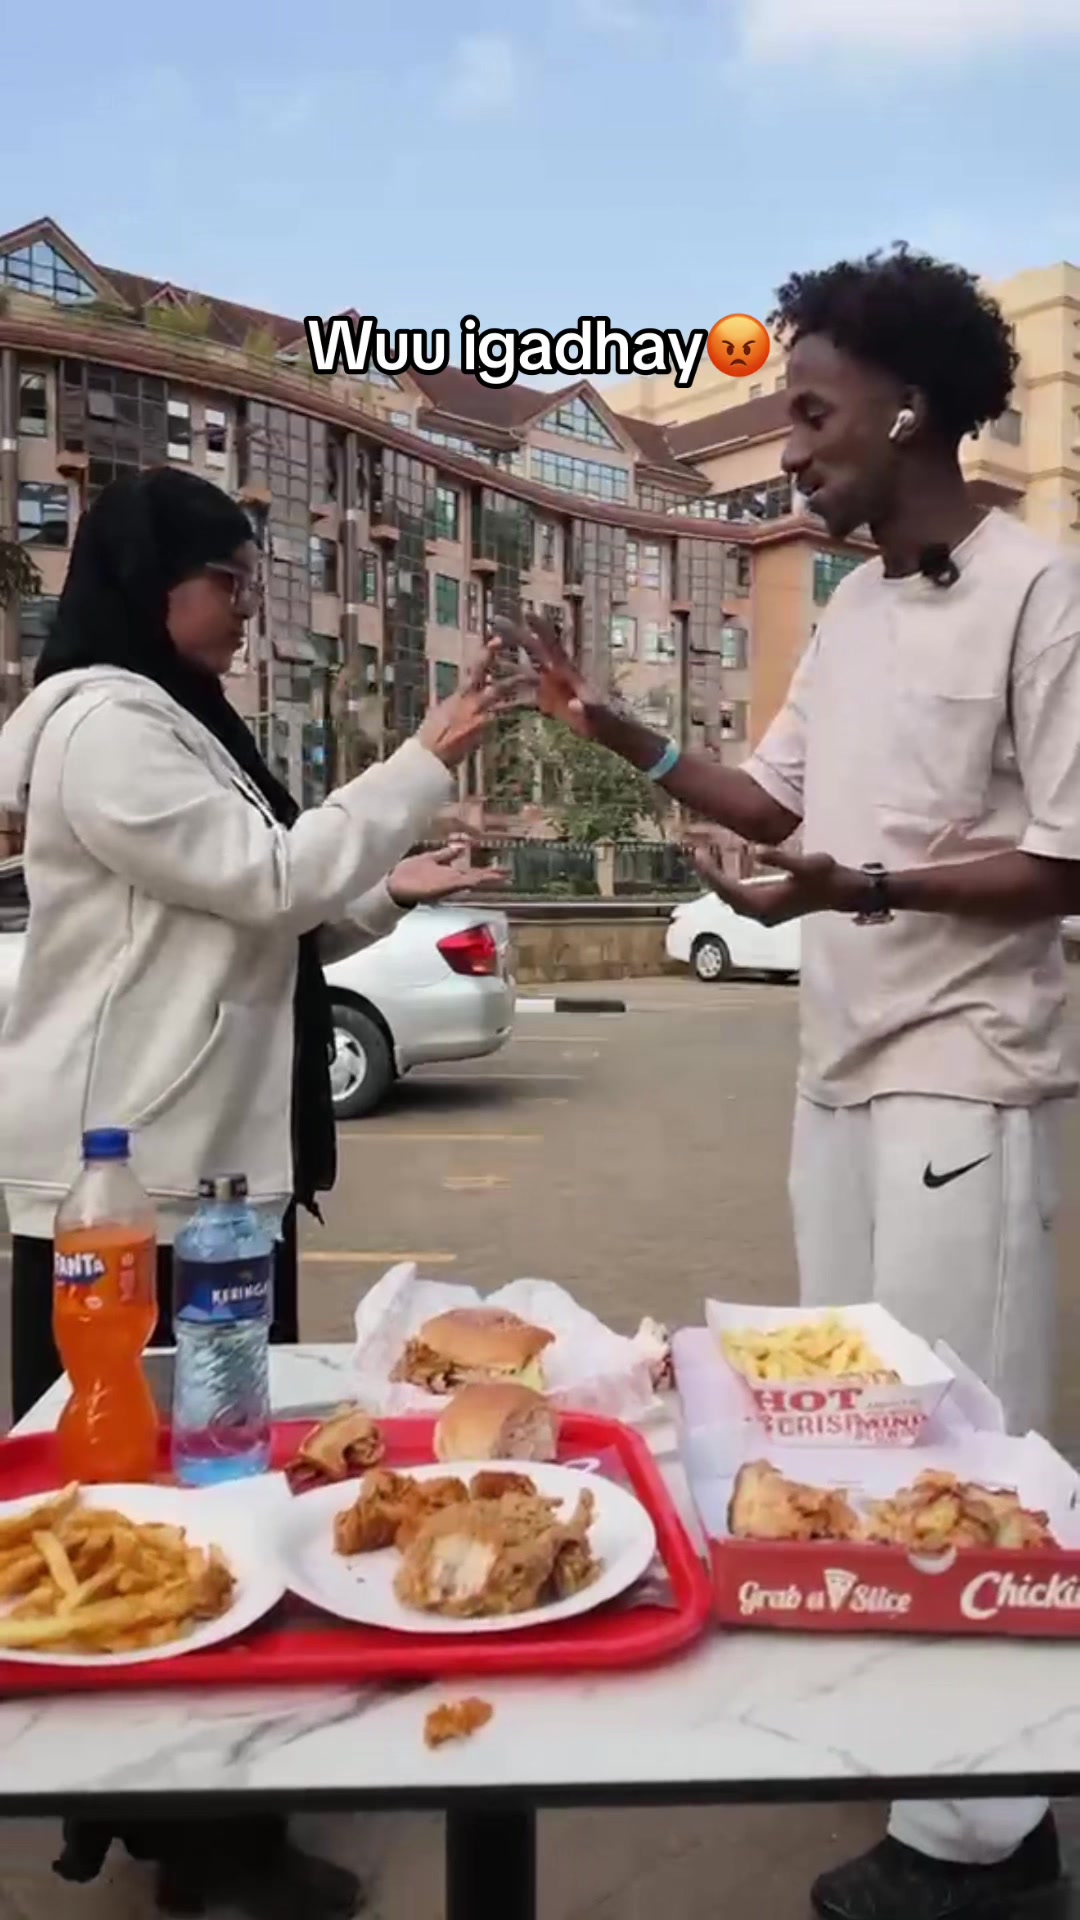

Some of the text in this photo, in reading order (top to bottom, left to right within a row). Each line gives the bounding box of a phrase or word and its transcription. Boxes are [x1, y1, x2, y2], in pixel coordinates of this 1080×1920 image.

[752, 1387, 863, 1412] HOT
[738, 1580, 912, 1615] Grab a Slice
